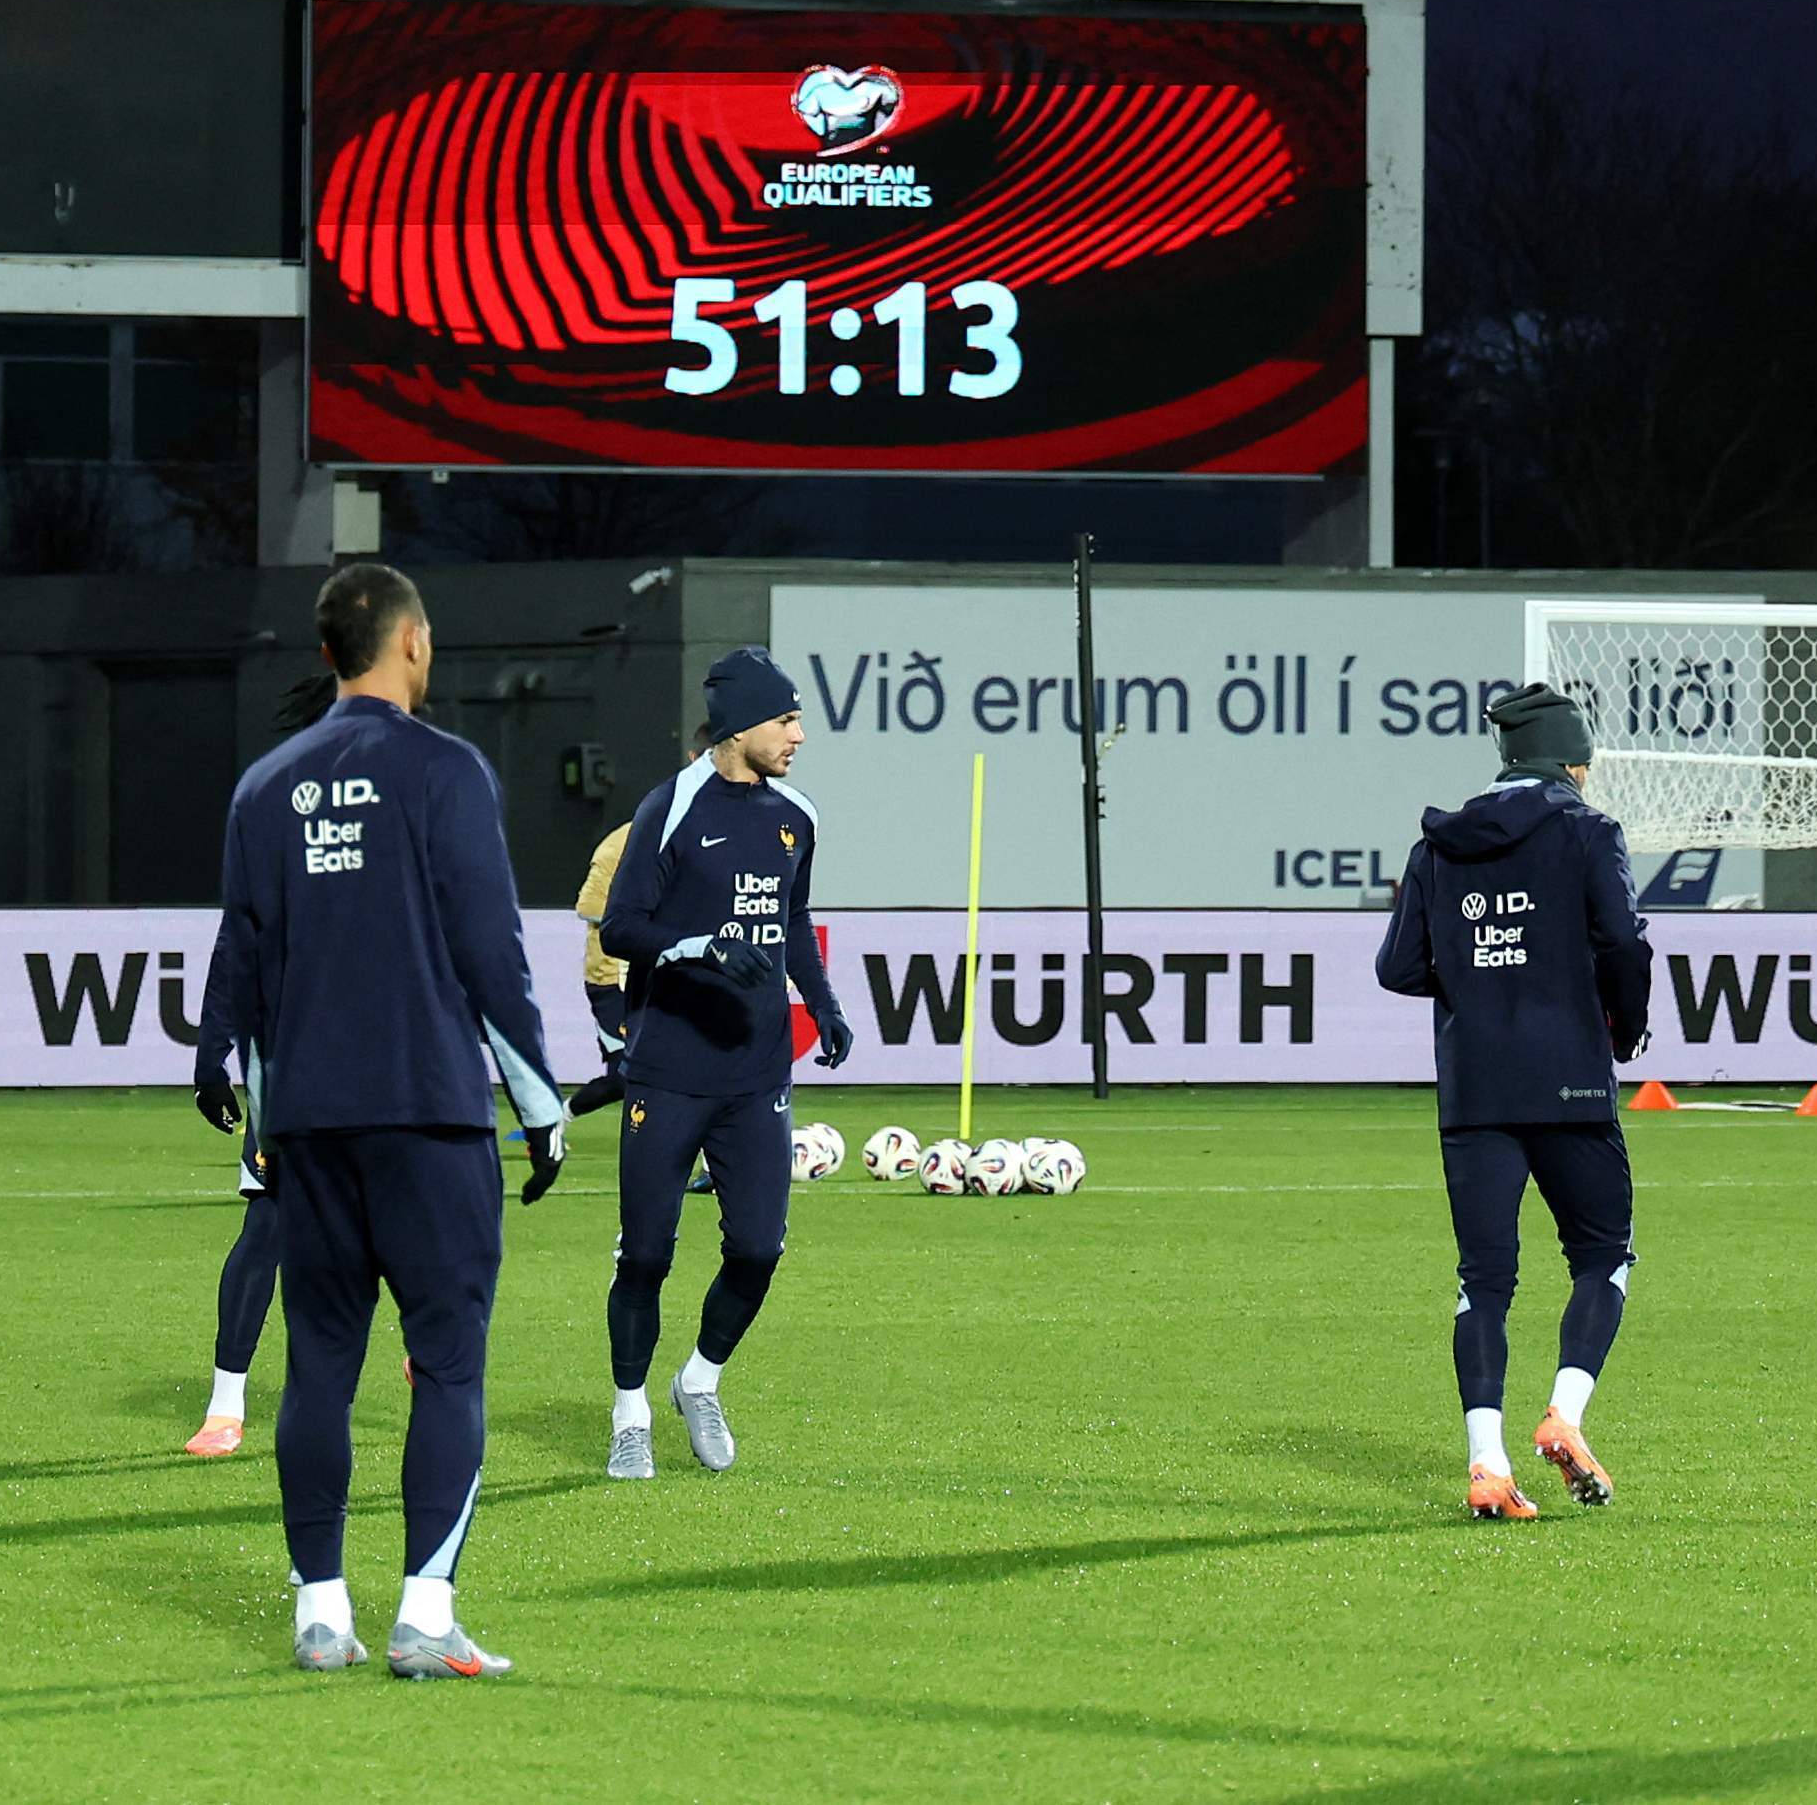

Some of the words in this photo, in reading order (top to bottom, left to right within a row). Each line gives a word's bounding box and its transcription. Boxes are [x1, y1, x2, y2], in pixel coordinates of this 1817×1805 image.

[781, 162, 916, 185] EUROPEAN
[763, 182, 933, 208] QUALIFIERS
[664, 277, 1023, 400] 51:13
[808, 650, 946, 735] Við
[972, 674, 1189, 735] erum
[1217, 654, 1308, 736] öll
[1336, 654, 1358, 735] í
[1379, 677, 1600, 737] sa
[304, 819, 363, 846] Uber
[305, 846, 364, 874] Eats
[1275, 848, 1400, 889] ICEL
[734, 873, 781, 894] Uber
[733, 894, 780, 915] Eats
[1474, 924, 1524, 946] Uber
[1473, 946, 1527, 967] Eats
[862, 952, 1315, 1048] WÜRTH
